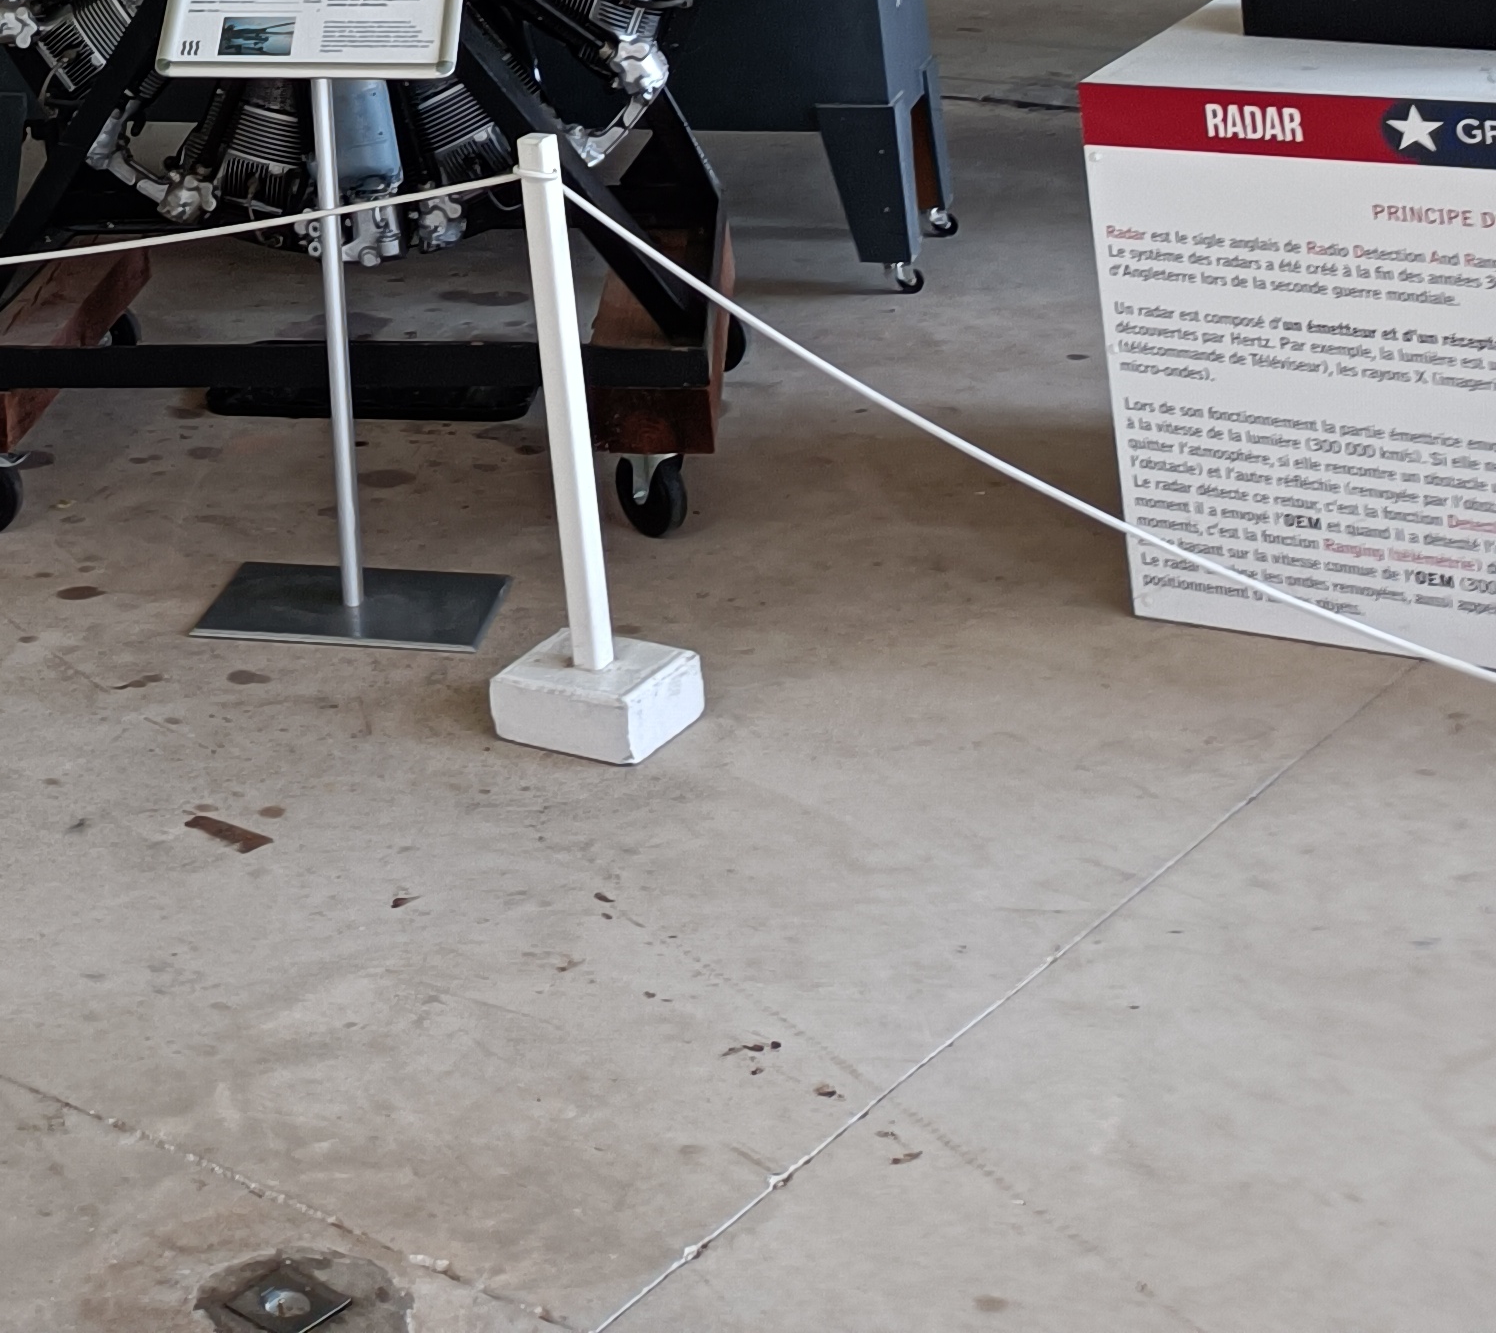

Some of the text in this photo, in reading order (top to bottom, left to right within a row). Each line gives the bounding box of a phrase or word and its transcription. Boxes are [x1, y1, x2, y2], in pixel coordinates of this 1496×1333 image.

[1205, 103, 1304, 143] RADAR
[1371, 203, 1474, 228] PRINCIPE
[1106, 225, 1146, 240] Radar
[1151, 231, 1172, 244] est
[1175, 231, 1188, 244] le
[1229, 237, 1280, 252] anglais
[1284, 240, 1301, 254] de
[1306, 241, 1349, 257] Radio
[1353, 245, 1426, 262] Detection
[1428, 250, 1460, 266] And
[1108, 244, 1126, 258] Le
[1129, 248, 1184, 263] système
[1188, 252, 1212, 266] des
[1216, 255, 1261, 270] radars
[1265, 261, 1274, 271] a
[1278, 259, 1301, 274] été
[1306, 263, 1338, 276] créé
[1342, 264, 1352, 277] à
[1356, 265, 1371, 279] la
[1374, 266, 1394, 281] fin
[1397, 268, 1425, 283] des
[1428, 274, 1483, 288] années
[1201, 272, 1227, 286] lors
[1231, 275, 1248, 288] de
[1253, 276, 1267, 290] la
[1270, 280, 1329, 296] seconde
[1332, 285, 1382, 300] guerre
[1114, 301, 1134, 315] Un
[1137, 305, 1175, 319] radar
[1179, 310, 1201, 322] est
[1204, 313, 1265, 329] composé
[1381, 327, 1399, 341] et
[1115, 320, 1199, 341] découvertes
[1202, 332, 1226, 345] par
[1279, 336, 1306, 351] Par
[1310, 343, 1376, 362] exemple,
[1379, 346, 1395, 361] la
[1398, 348, 1457, 367] lumière
[1229, 351, 1247, 365] de
[1336, 361, 1358, 377] les
[1361, 368, 1412, 383] rayons
[1124, 396, 1156, 413] Lors
[1158, 401, 1176, 415] de
[1179, 406, 1204, 418] son
[1208, 406, 1318, 431] fonctionnement
[1321, 419, 1336, 434] la
[1126, 416, 1136, 429] à
[1138, 417, 1152, 431] la
[1155, 421, 1203, 438] vitesse
[1206, 426, 1224, 440] de
[1228, 428, 1242, 442] la
[1245, 430, 1302, 449] lumière
[1206, 466, 1222, 479] et
[1276, 454, 1290, 467] si
[1293, 456, 1322, 472] elle
[1132, 474, 1151, 488] Le
[1155, 479, 1192, 493] radar
[1196, 483, 1250, 501] détecte
[1252, 492, 1271, 504] ce
[1134, 497, 1191, 513] moment
[1208, 506, 1217, 517] a
[1220, 508, 1271, 525] envoyé
[1243, 528, 1258, 542] la
[1261, 530, 1319, 549] fonction
[1140, 552, 1159, 566] Le
[1162, 557, 1199, 572] radar
[1227, 548, 1250, 559] sur
[1254, 549, 1268, 562] la
[1271, 552, 1321, 570] vitesse
[1143, 574, 1249, 599] positionnement
